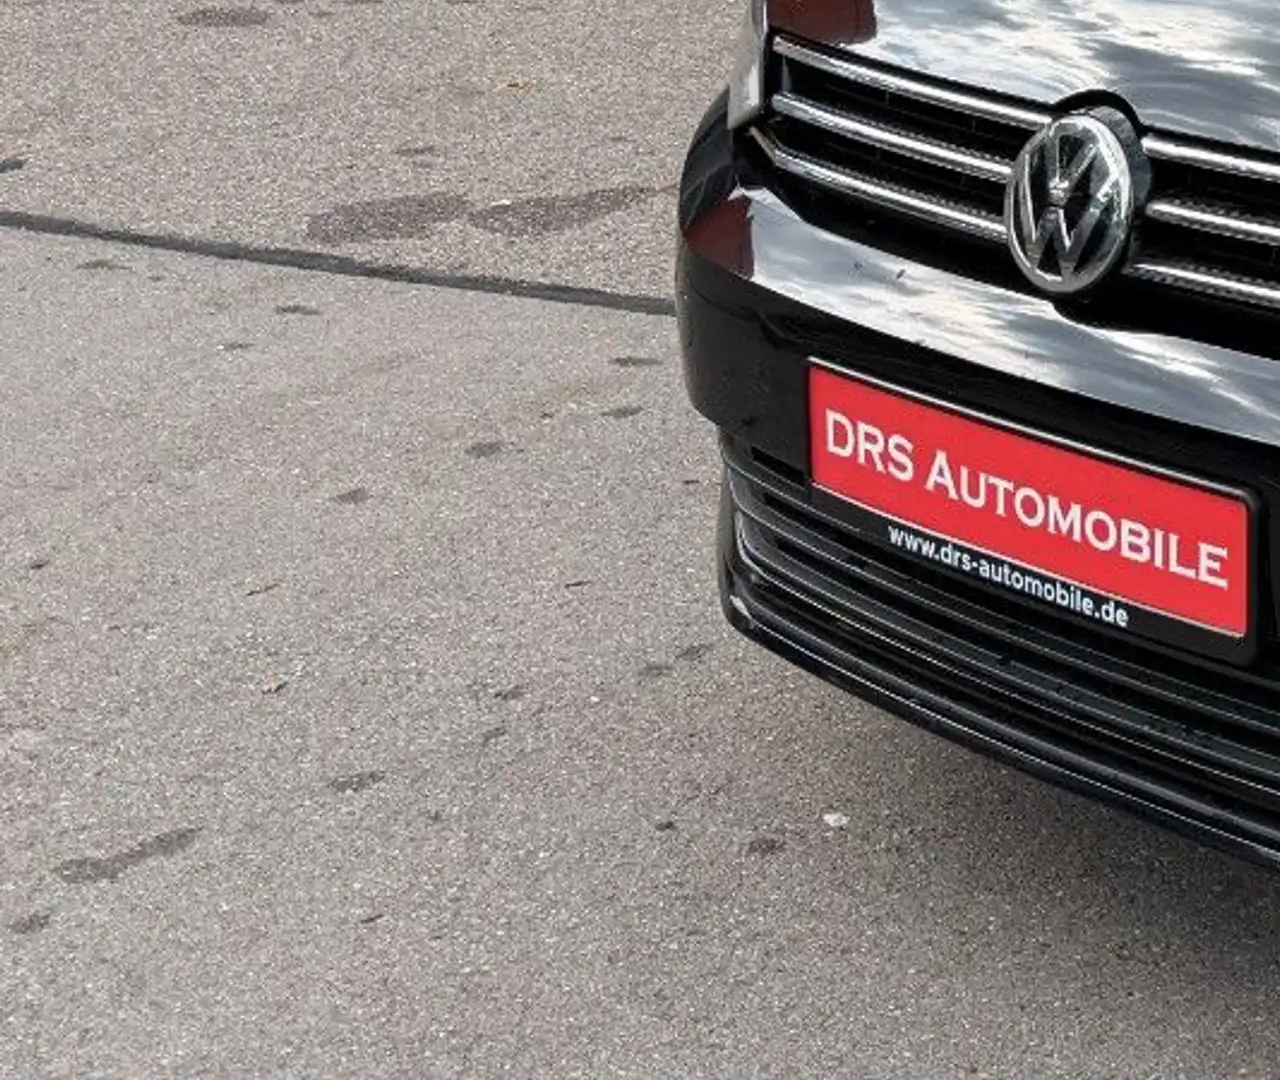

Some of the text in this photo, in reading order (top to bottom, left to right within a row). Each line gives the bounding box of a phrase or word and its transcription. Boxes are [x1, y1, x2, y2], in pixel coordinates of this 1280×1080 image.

[825, 408, 1229, 592] DRS AUTOMOBILE
[887, 524, 1129, 627] www.drs-automobile.de
